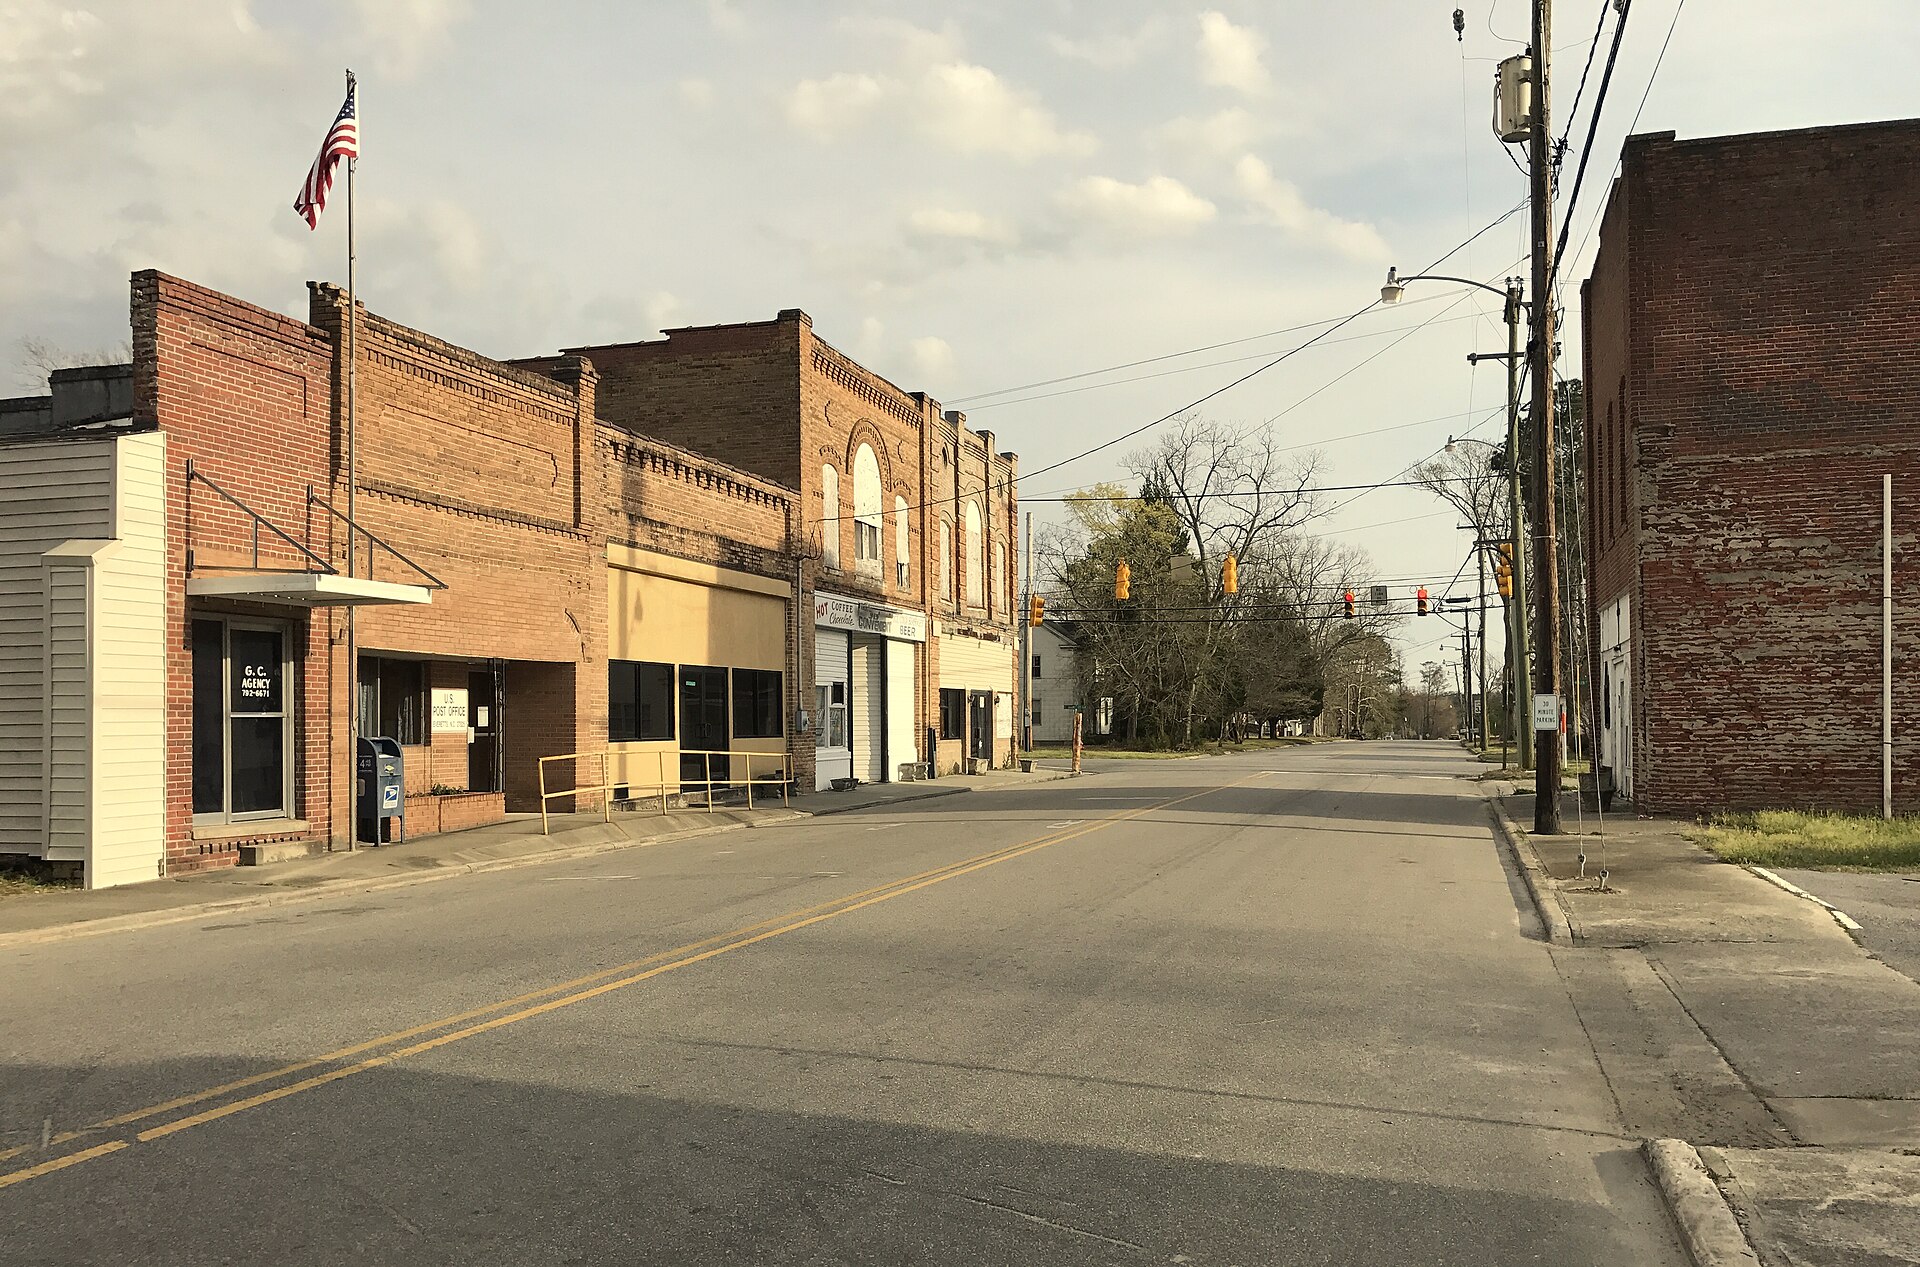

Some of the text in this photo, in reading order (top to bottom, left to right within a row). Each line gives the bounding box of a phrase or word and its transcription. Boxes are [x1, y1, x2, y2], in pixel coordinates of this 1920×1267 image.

[816, 602, 828, 619] HOT
[832, 601, 854, 613] COFFEE
[900, 625, 916, 637] BEER
[245, 665, 267, 676] G. C.
[242, 678, 271, 689] AGENCY
[433, 705, 447, 717] POST
[448, 705, 466, 717] OFFICE
